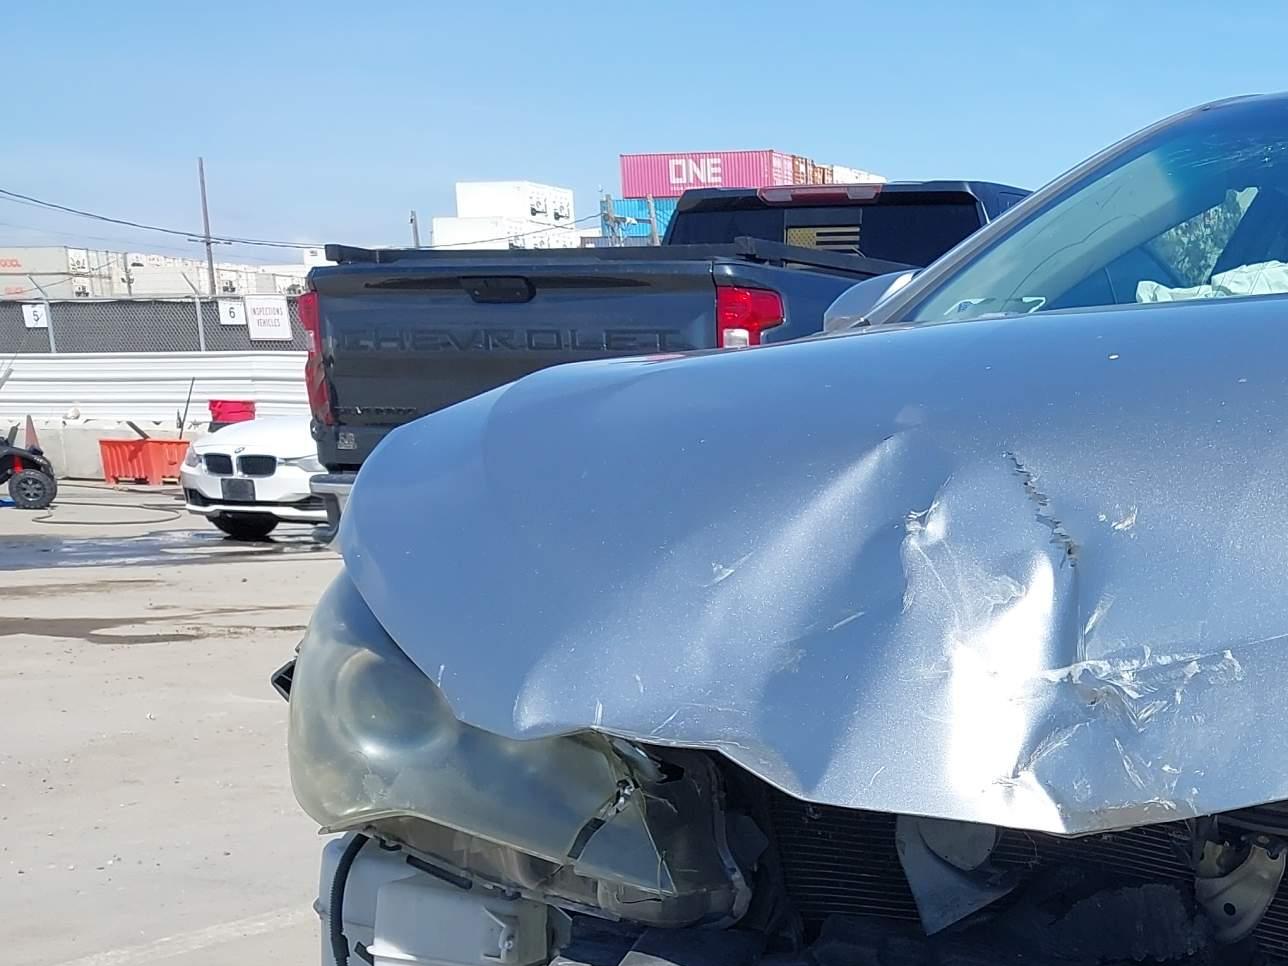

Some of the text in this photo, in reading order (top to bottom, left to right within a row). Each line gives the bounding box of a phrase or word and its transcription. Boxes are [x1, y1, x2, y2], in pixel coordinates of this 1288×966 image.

[668, 157, 722, 185] ONE
[32, 310, 40, 322] 5
[228, 306, 236, 319] 6
[336, 328, 682, 351] CHEVROLET
